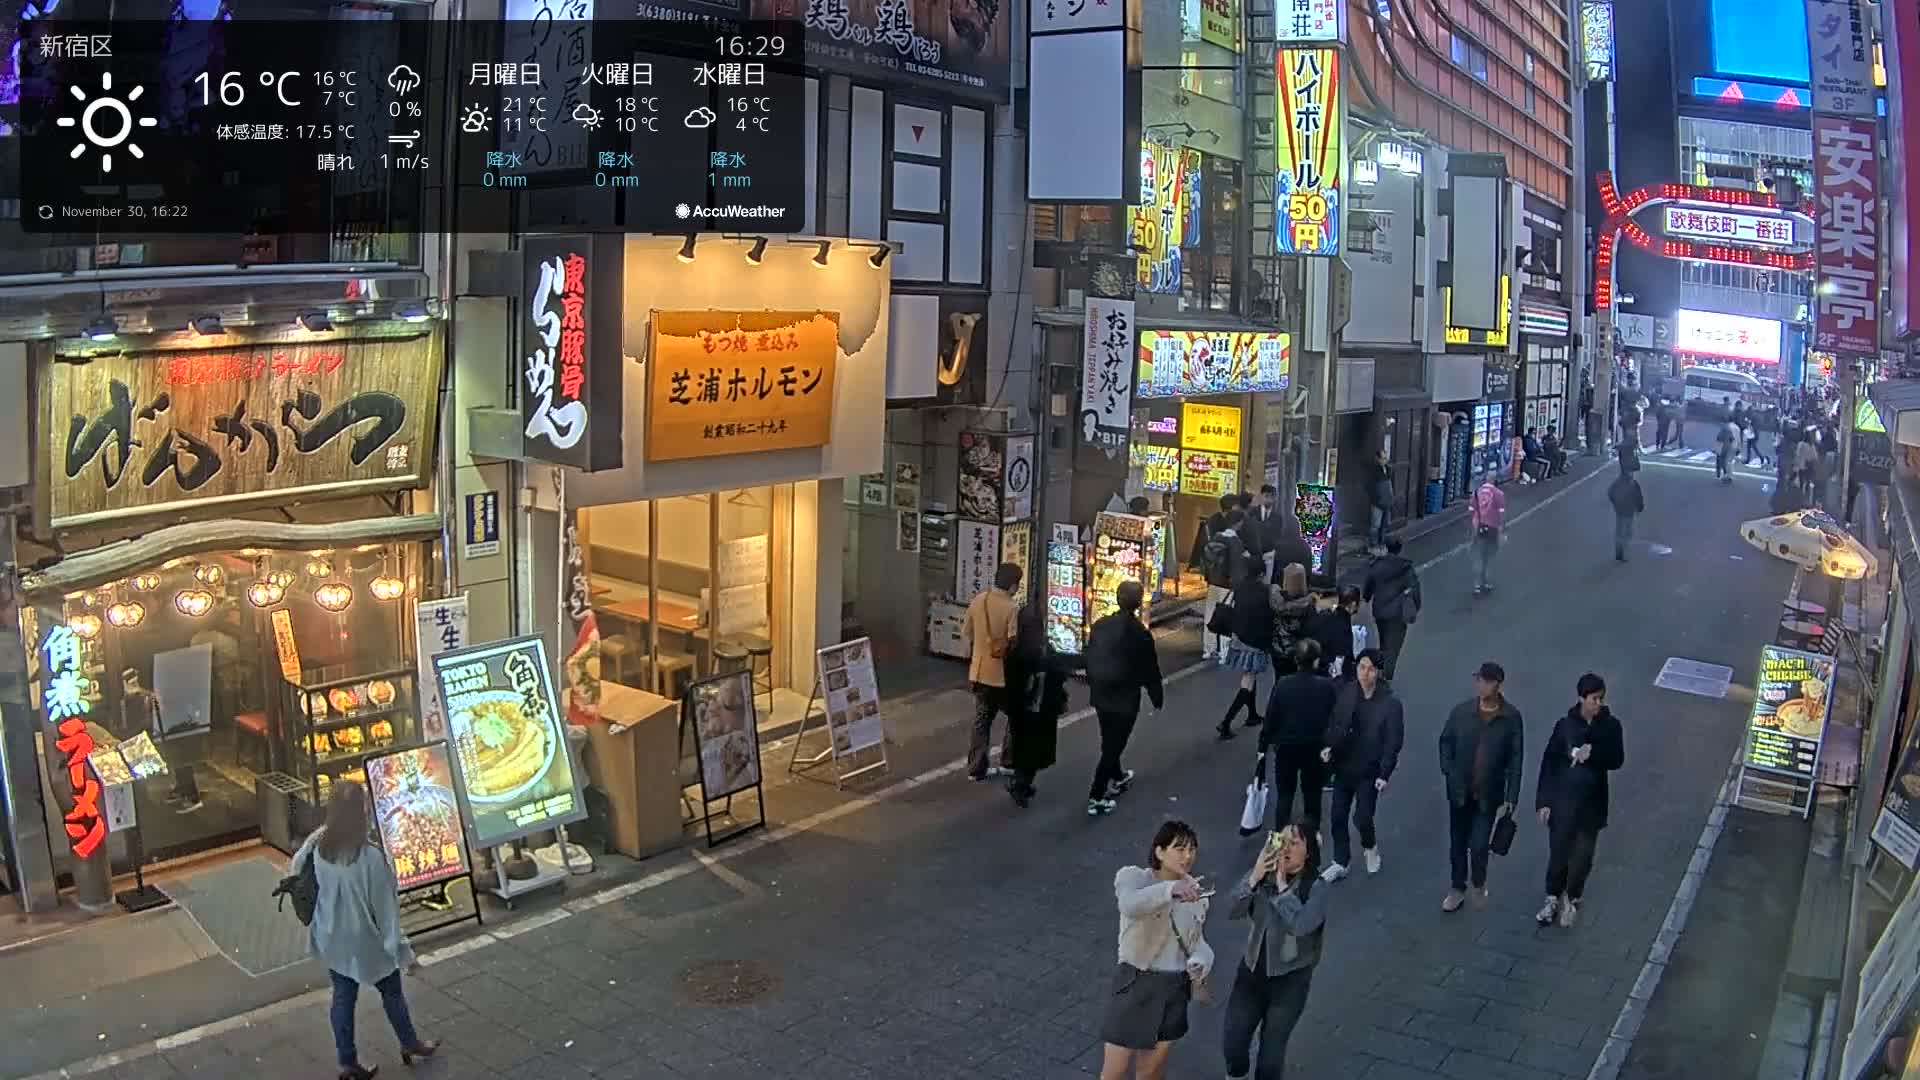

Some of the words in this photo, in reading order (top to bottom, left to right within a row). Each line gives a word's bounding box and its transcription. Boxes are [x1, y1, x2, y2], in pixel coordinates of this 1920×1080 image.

[1295, 54, 1322, 189] ハイボール
[1289, 194, 1327, 220] 50
[1294, 222, 1320, 250] 円
[1670, 211, 1789, 241] 歌舞伎町一番街
[1820, 126, 1876, 329] 安楽亭
[560, 253, 585, 400] 東京豚骨
[1099, 308, 1129, 414] お好み焼き
[668, 366, 825, 406] 芝浦ホルモン
[66, 378, 406, 493] ばんから
[1102, 432, 1127, 446] B1F
